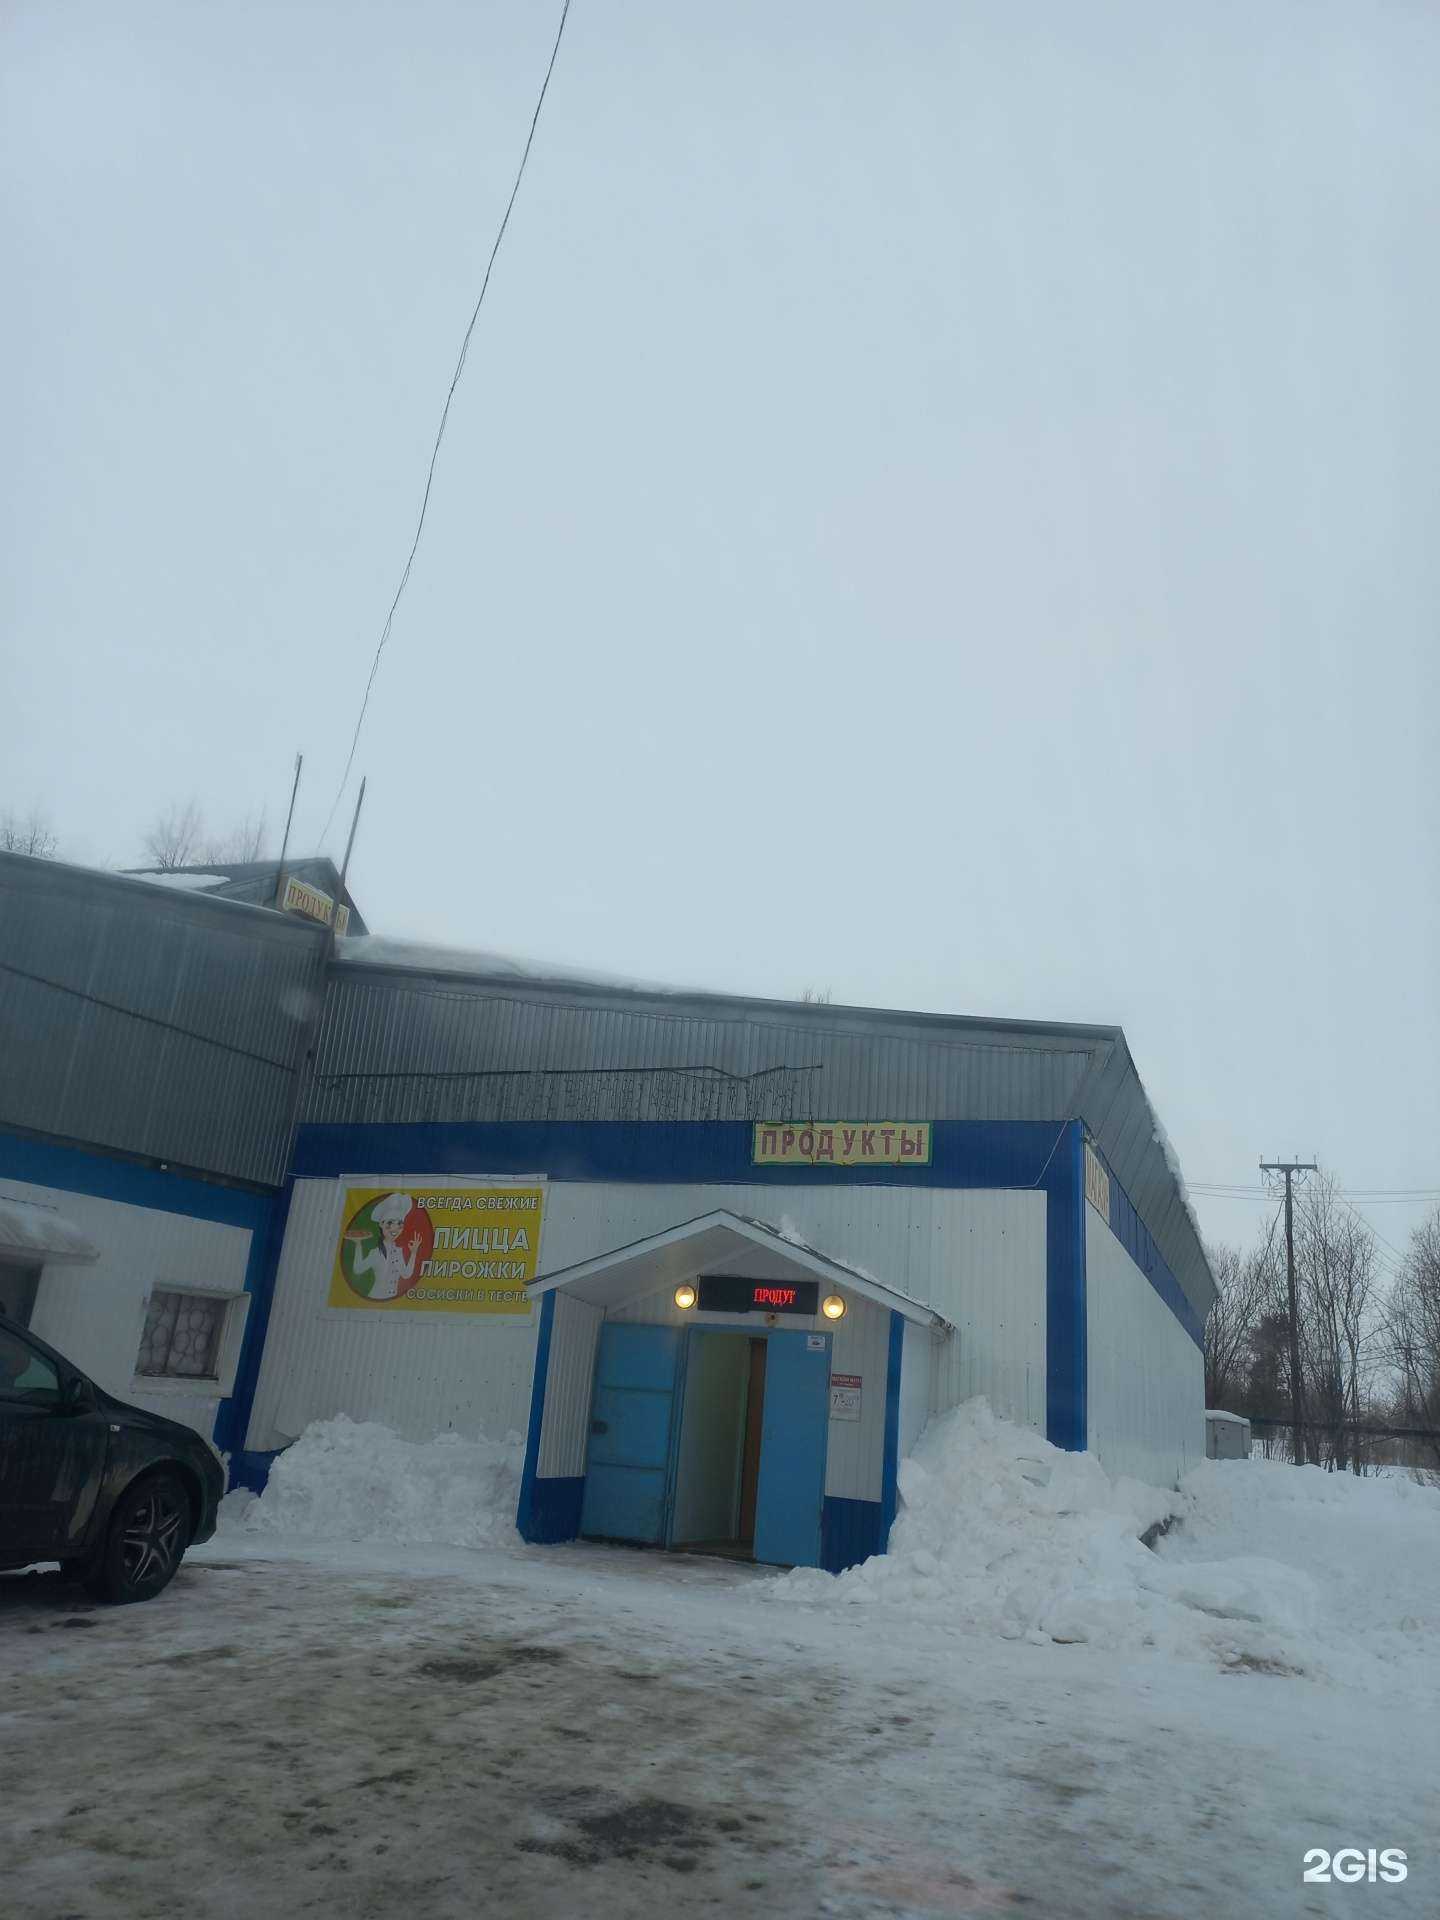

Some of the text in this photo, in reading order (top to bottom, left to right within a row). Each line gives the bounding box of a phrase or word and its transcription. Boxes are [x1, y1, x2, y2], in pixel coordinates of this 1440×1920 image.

[760, 1129, 923, 1161] ПРОДУКТЫ
[417, 1196, 538, 1211] ВСЕГДА СВЕЖИЕ
[433, 1227, 529, 1254] ПИЦЦА
[419, 1260, 526, 1279] ПИРОЖКИ
[406, 1288, 476, 1302] СОСИСКИ
[489, 1291, 528, 1304] ТЕСТЕ
